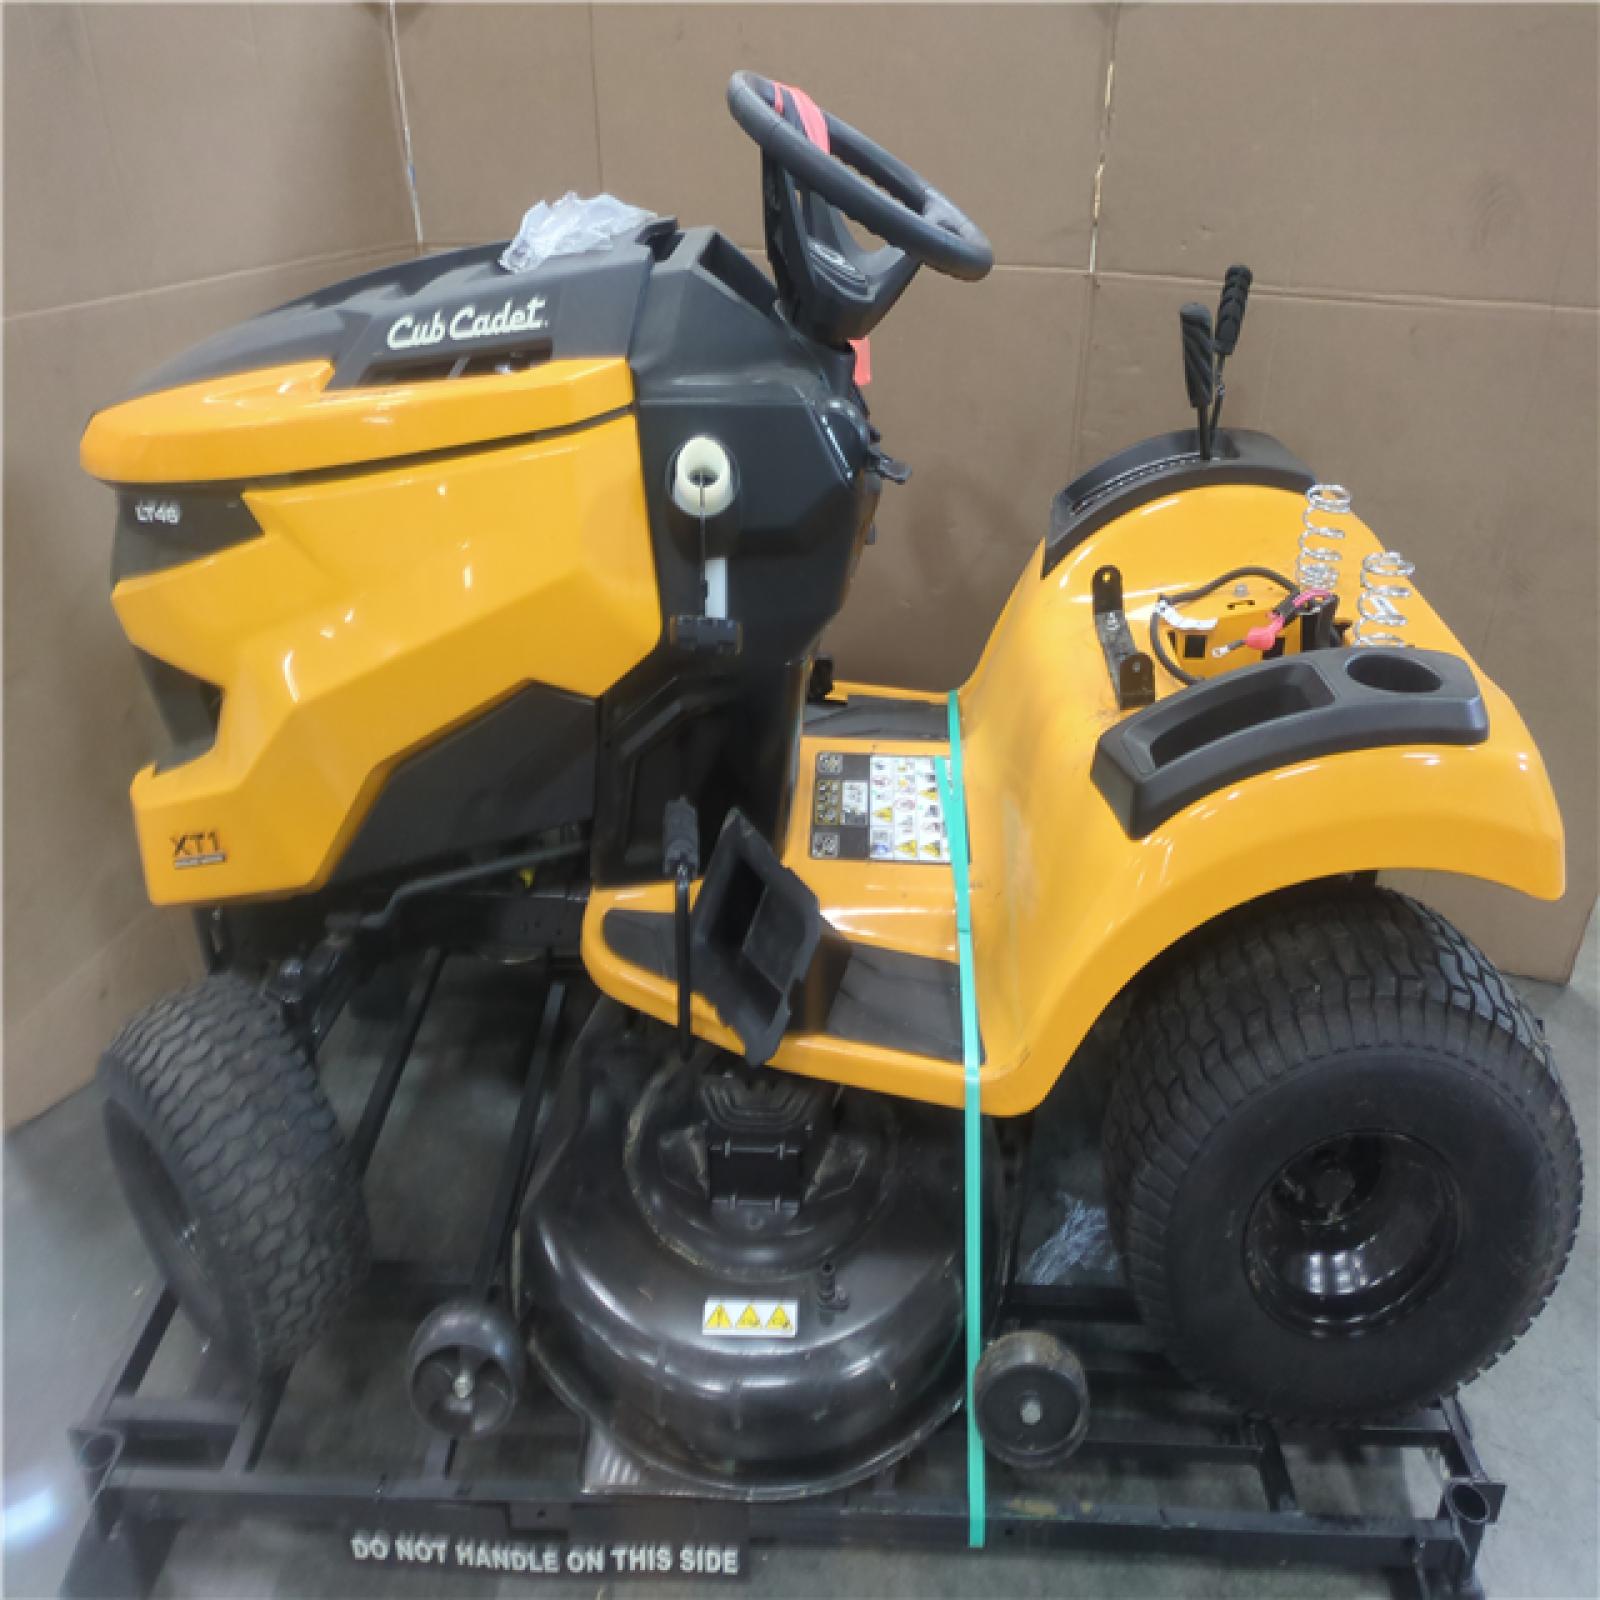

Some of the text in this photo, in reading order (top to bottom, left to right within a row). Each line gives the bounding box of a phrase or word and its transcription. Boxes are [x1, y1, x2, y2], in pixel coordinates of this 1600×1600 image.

[387, 295, 546, 349] Cub Cadet
[170, 832, 219, 857] XT1
[352, 1536, 739, 1575] DO NOT HANDLE ON THIS SIDE
